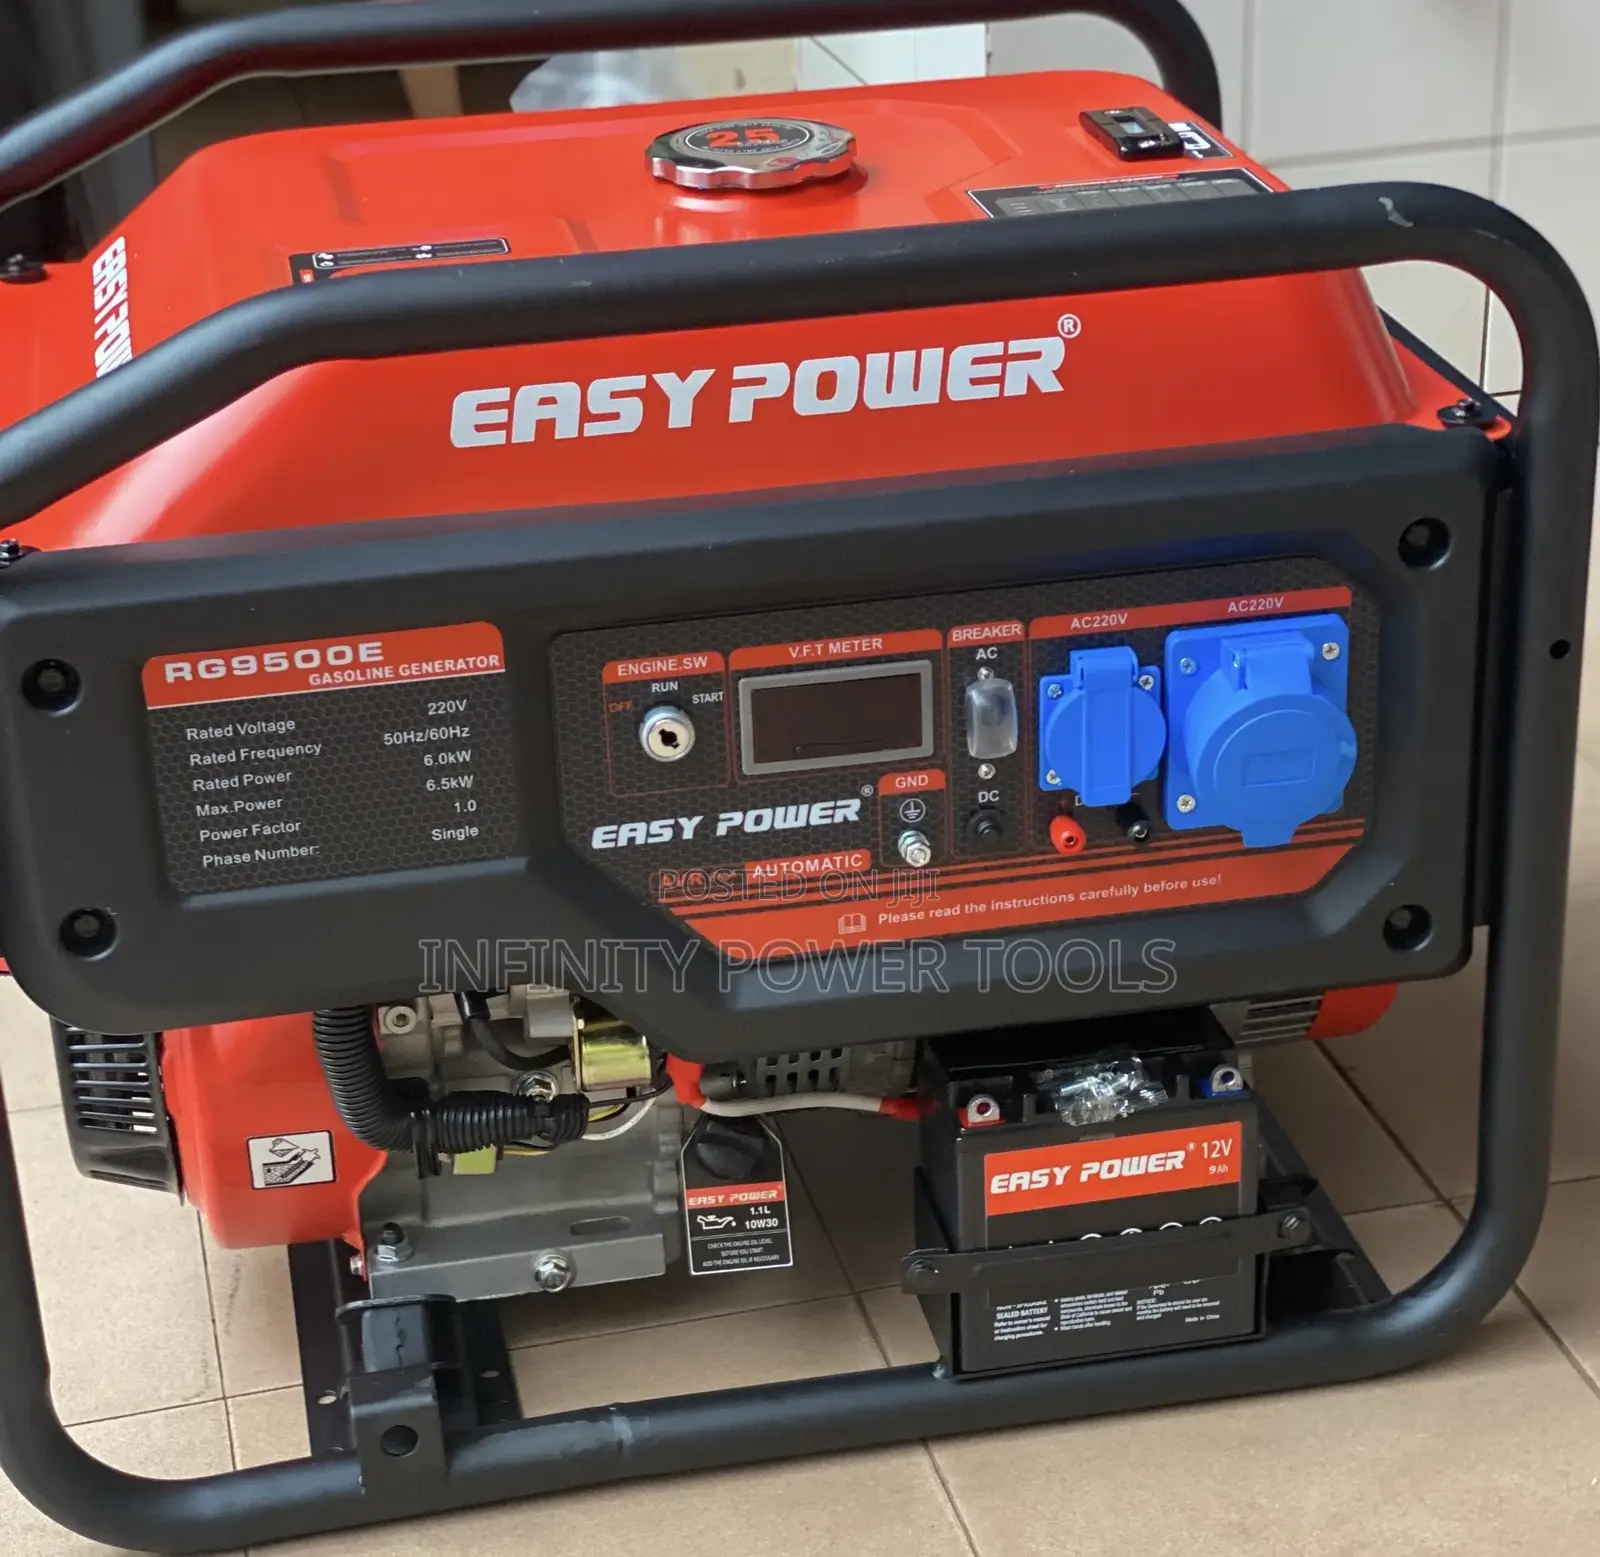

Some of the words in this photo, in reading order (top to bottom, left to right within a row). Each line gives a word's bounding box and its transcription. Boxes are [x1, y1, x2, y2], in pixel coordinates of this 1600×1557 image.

[92, 236, 128, 326] EASY
[450, 368, 716, 449] EASY
[729, 336, 1066, 424] POWER
[1227, 597, 1284, 613] AC220V
[1070, 613, 1128, 629] AC220V
[952, 623, 1022, 641] BREAKER
[789, 644, 823, 659] V.F.T
[828, 638, 883, 654] METER
[975, 646, 998, 660] AC
[164, 641, 385, 683] RG9500E
[308, 665, 394, 686] GASOLINE
[399, 654, 500, 677] GENERATOR
[617, 655, 708, 677] ENGINE.SW
[651, 680, 679, 693] RUN
[692, 690, 724, 704] START
[427, 699, 467, 715] 220V
[186, 724, 233, 740] Rated
[236, 720, 296, 735] Voltage
[383, 725, 470, 745] 50Hz/60Hz
[189, 751, 236, 766] Rated
[240, 743, 322, 761] Frequency
[424, 750, 471, 766] 6.0kW
[192, 775, 239, 791] Rated
[243, 771, 292, 786] Power
[426, 774, 474, 791] 6.5kW
[895, 774, 929, 788] GND
[978, 790, 1000, 803] DC
[454, 799, 477, 813] 1.0
[199, 827, 248, 842] Power
[251, 821, 301, 836] Factor
[591, 815, 704, 850] EASY
[715, 798, 862, 837] POWER
[431, 825, 479, 841] Single
[202, 852, 251, 868] Phase
[752, 853, 863, 879] AUTOMATIC
[878, 908, 925, 925] Please
[929, 904, 960, 918] read
[964, 901, 987, 914] the
[991, 892, 1075, 910] instructions
[1079, 883, 1139, 901] carefully
[1143, 879, 1188, 894] before
[1192, 874, 1222, 888] use!
[990, 1165, 1072, 1194] EASY
[1079, 1150, 1186, 1182] POWER
[1201, 1138, 1232, 1159] 12V
[688, 1194, 725, 1206] EASY
[730, 1189, 778, 1202] POWER
[749, 1205, 771, 1215] 1.1L
[745, 1217, 779, 1229] 10W30
[996, 1310, 1020, 1319] SEALED
[1020, 1306, 1048, 1316] BATTERY
